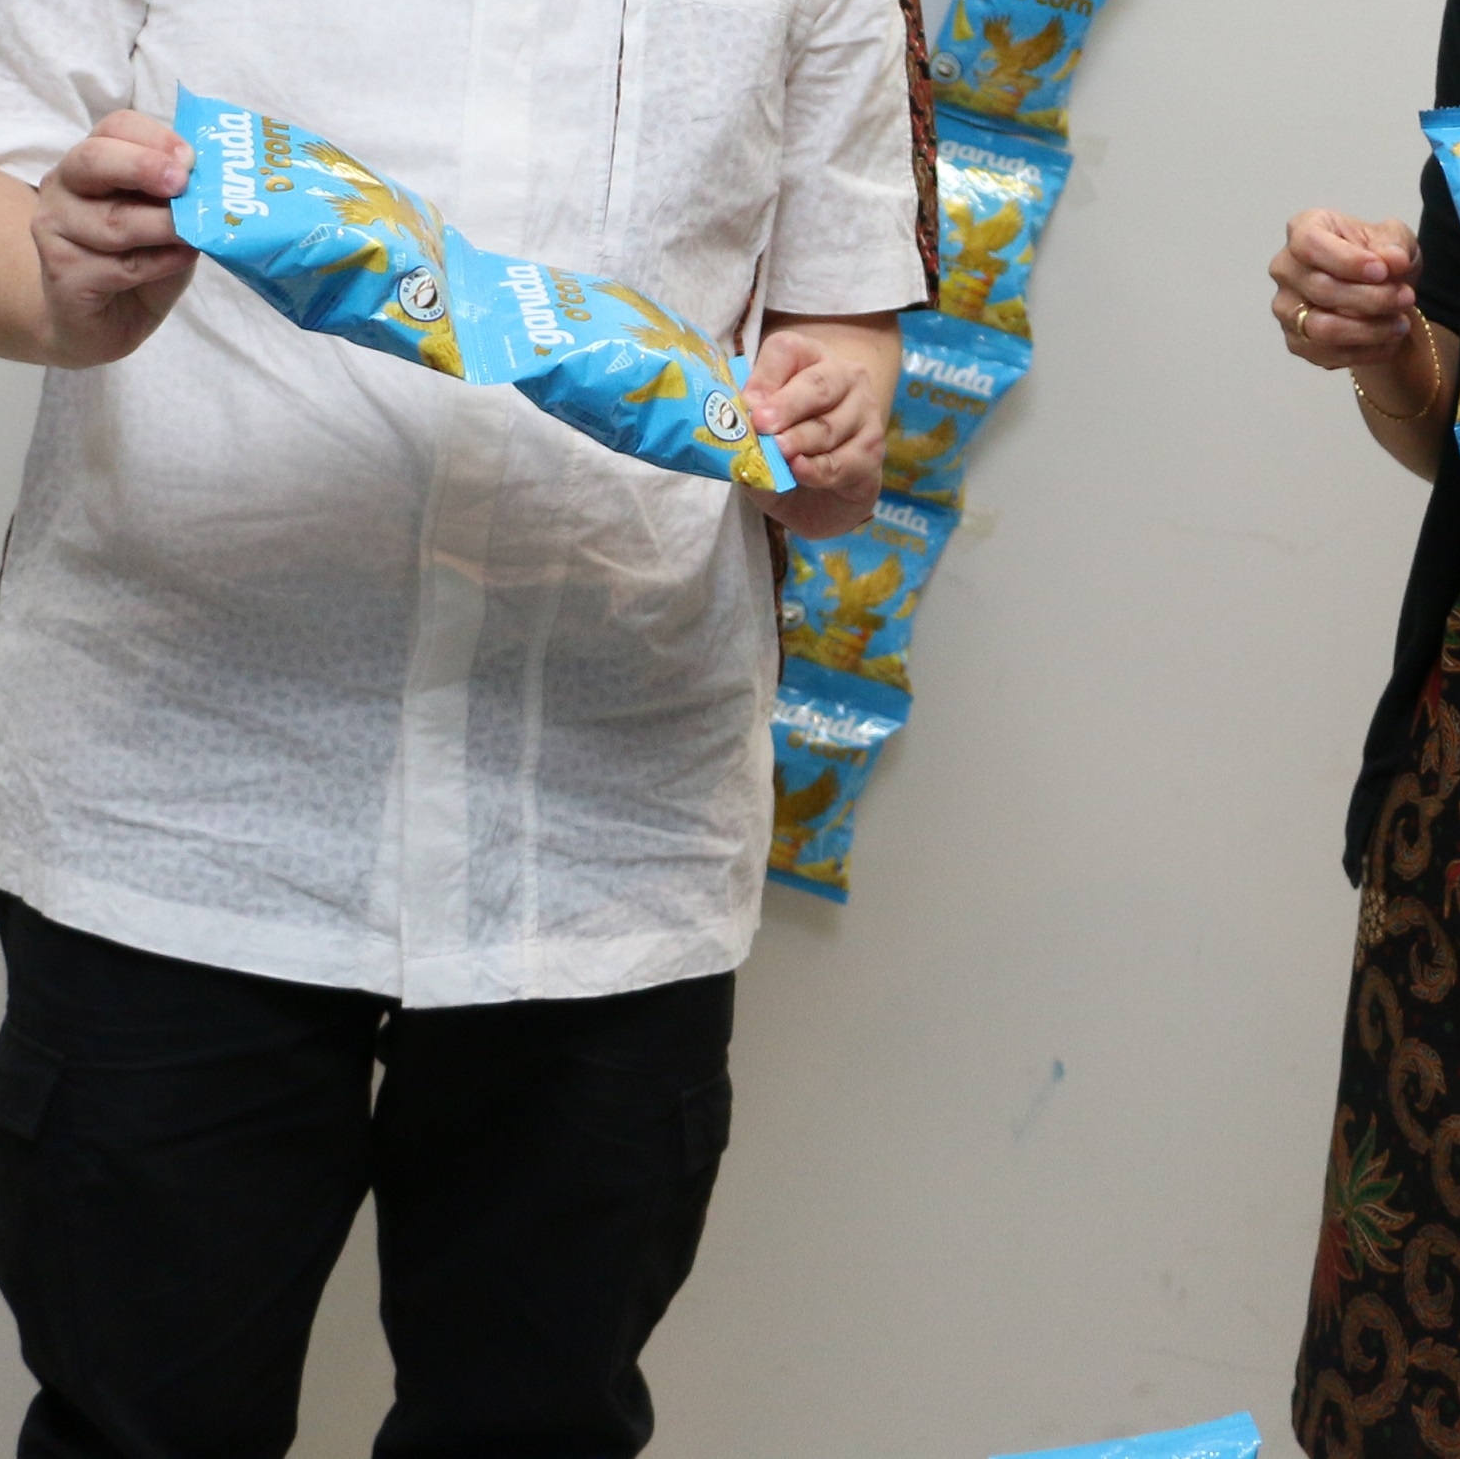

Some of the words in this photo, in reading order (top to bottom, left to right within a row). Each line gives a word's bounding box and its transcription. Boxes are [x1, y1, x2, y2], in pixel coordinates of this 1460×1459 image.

[209, 110, 270, 218] garuda
[258, 115, 295, 194] o'corn
[937, 139, 1042, 185] garuda
[498, 263, 576, 345] garuda
[547, 266, 593, 323] o'corn
[902, 348, 996, 398] aruda
[906, 380, 990, 417] o'corn
[872, 499, 930, 537] uda
